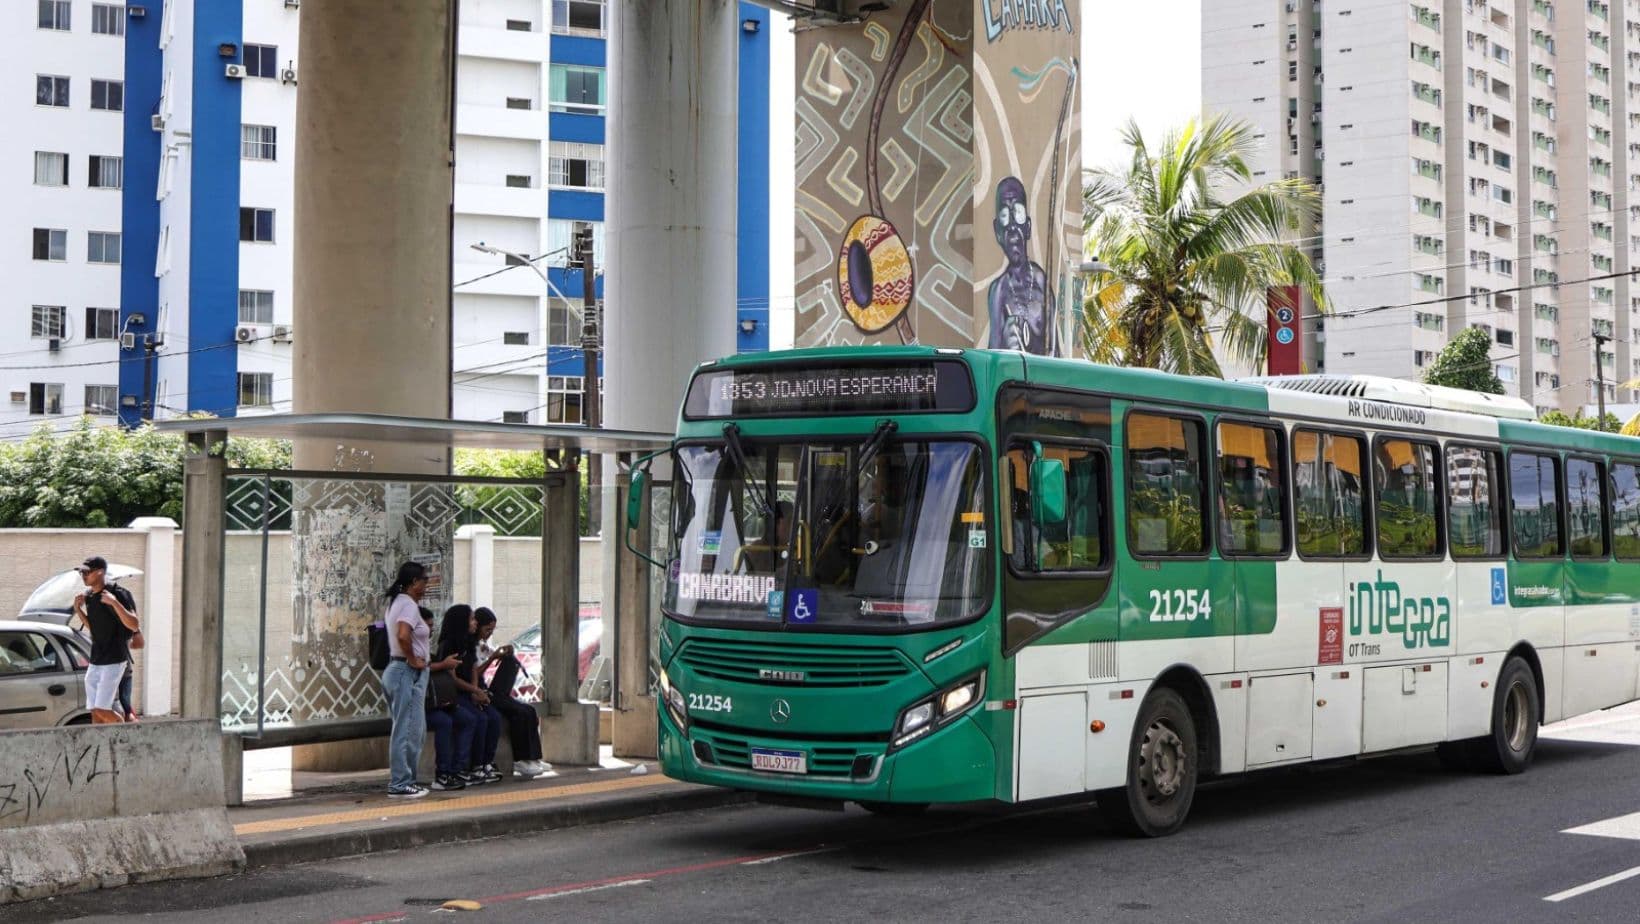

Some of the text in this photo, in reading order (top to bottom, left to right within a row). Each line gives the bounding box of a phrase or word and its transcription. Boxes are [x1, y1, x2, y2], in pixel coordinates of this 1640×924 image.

[1281, 310, 1288, 320] 2
[1348, 400, 1426, 425] AR CONDICIONADO
[680, 573, 775, 604] CANABRAVA
[1149, 588, 1212, 622] 21254
[1349, 643, 1359, 657] OT
[1361, 643, 1381, 656] Trans
[689, 692, 732, 713] 21254
